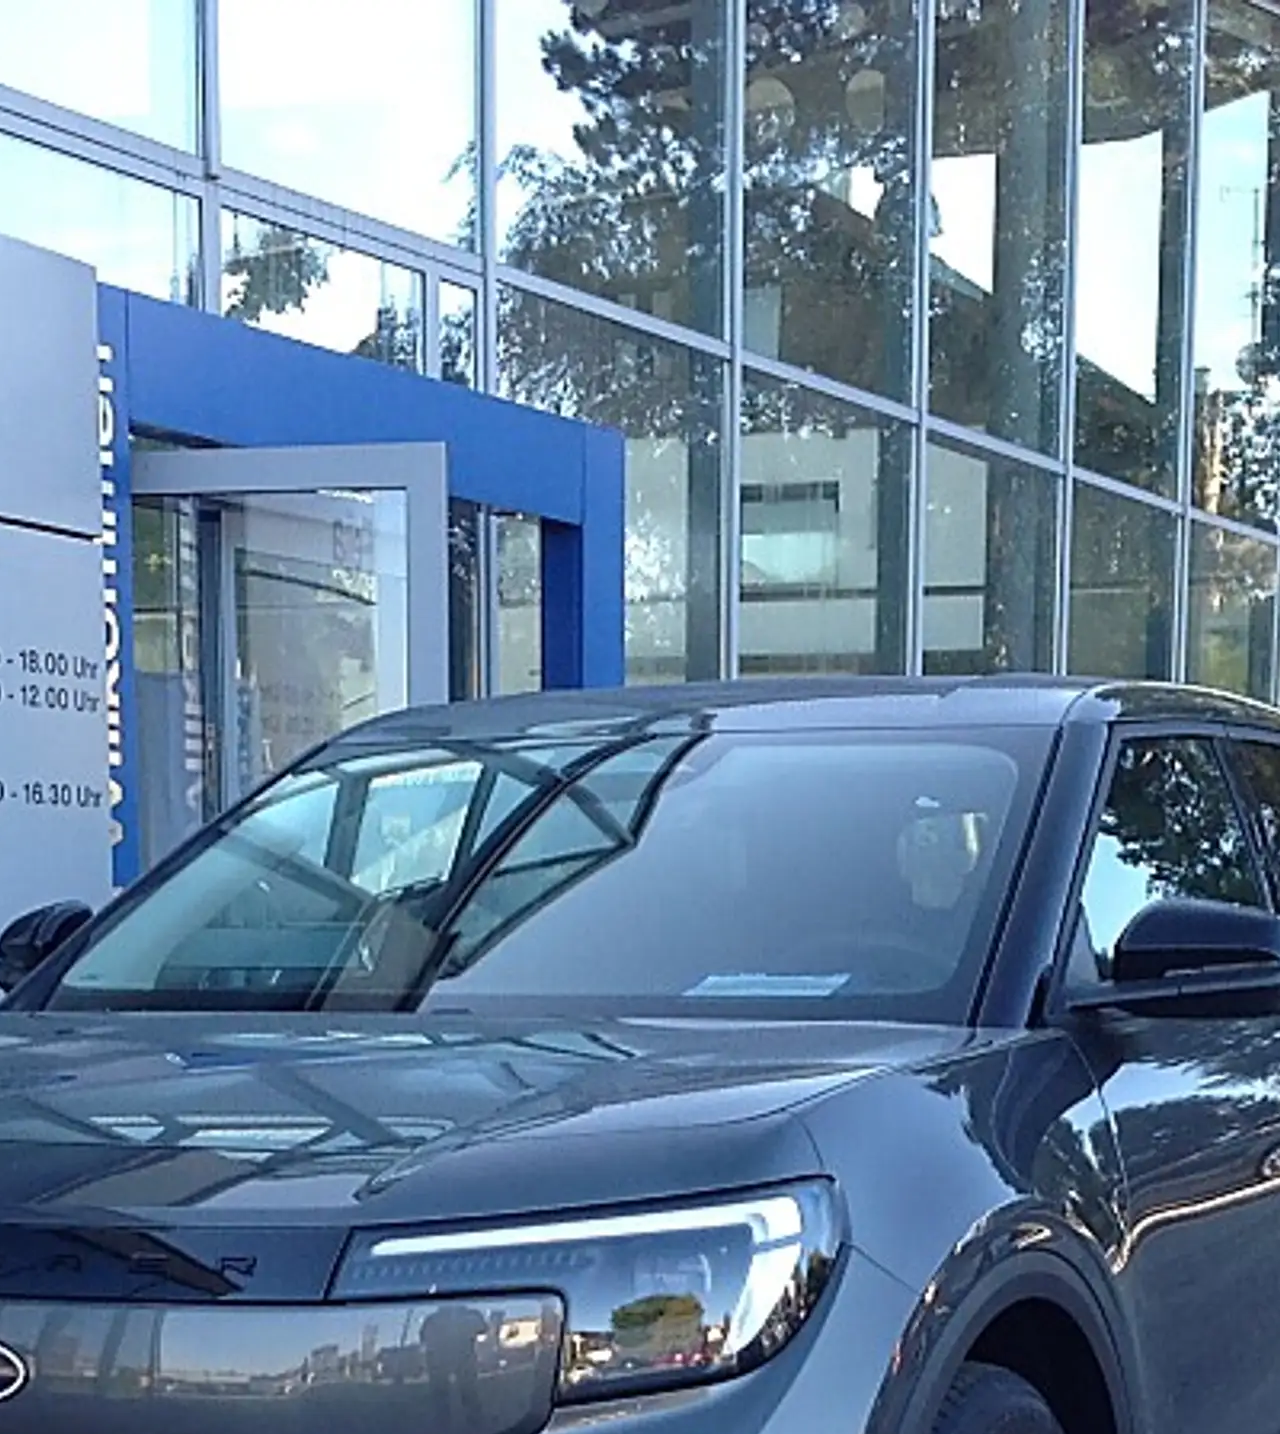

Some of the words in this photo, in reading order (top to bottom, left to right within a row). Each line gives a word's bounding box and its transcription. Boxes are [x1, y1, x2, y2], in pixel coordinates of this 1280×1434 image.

[74, 656, 99, 680] Uhr
[74, 691, 100, 714] Uhr
[24, 783, 71, 807] 16.30
[77, 785, 102, 808] Uhr
